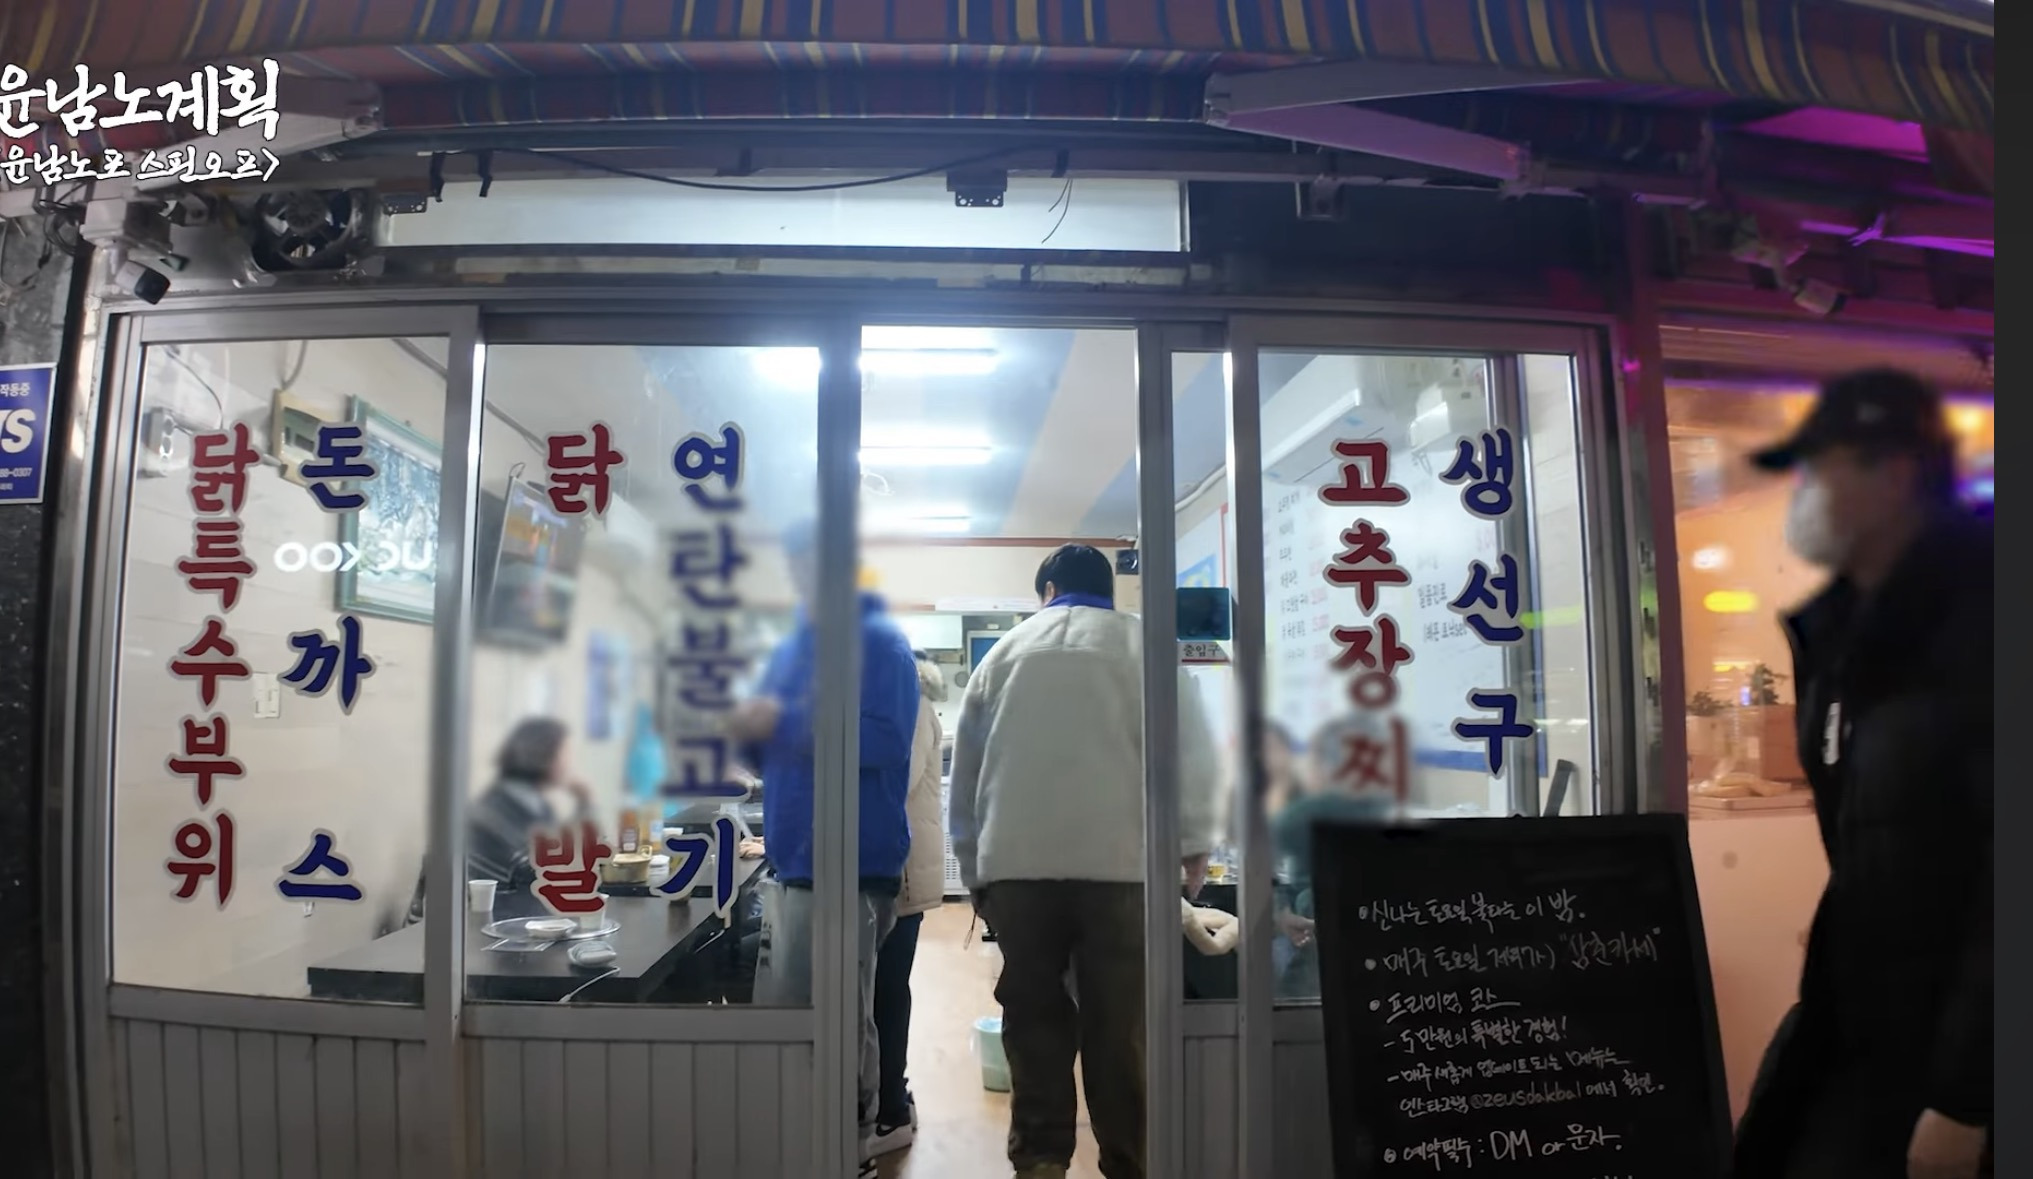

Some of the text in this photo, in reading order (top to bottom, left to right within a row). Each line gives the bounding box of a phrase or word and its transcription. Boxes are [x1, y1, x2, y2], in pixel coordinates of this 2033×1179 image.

[168, 423, 260, 905] 닭특수부위
[279, 426, 375, 901] 돈까스
[538, 424, 623, 912] 닭발
[658, 426, 748, 910] 연탄불고기
[1322, 441, 1412, 802] 고추장찌
[1442, 429, 1534, 817] 생선구
[1489, 1129, 1533, 1161] DM
